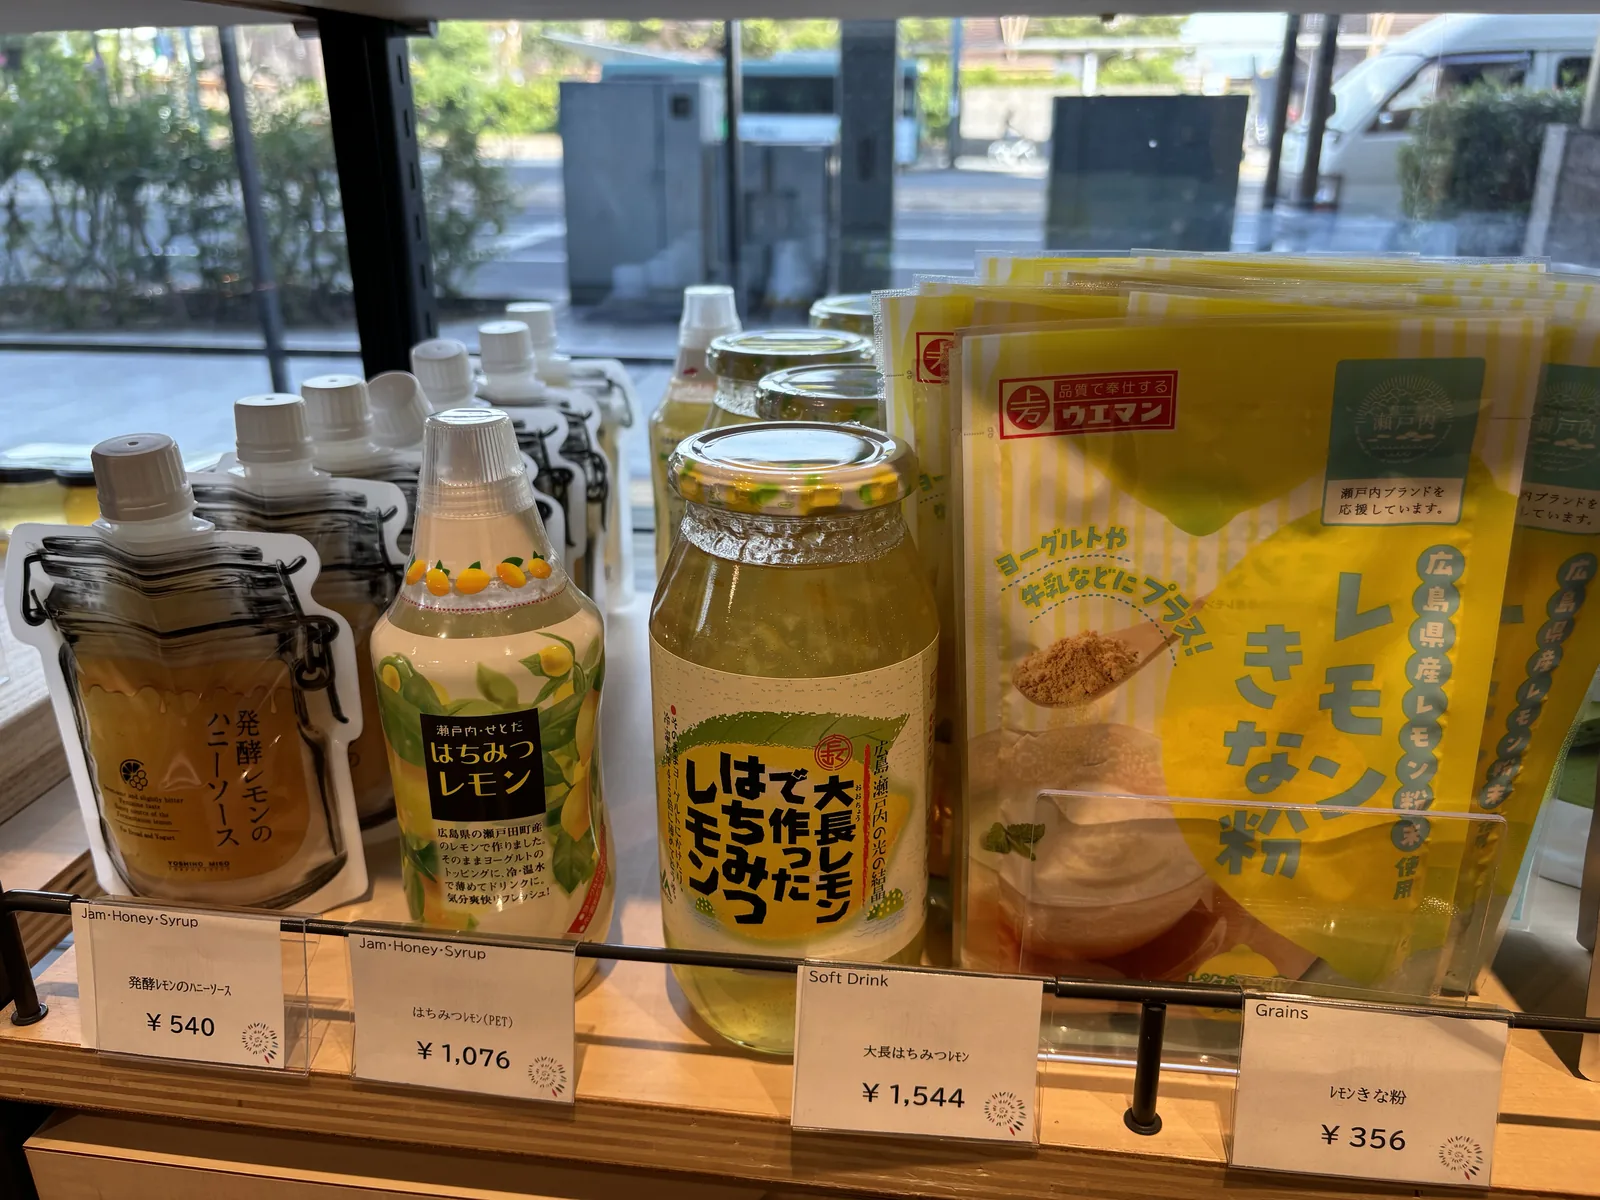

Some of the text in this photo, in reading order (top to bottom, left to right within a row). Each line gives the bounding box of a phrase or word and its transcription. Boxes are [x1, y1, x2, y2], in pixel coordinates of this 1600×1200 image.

[1059, 380, 1168, 398] 品質で奉仕する
[1062, 403, 1162, 426] ウエマン
[1340, 486, 1444, 499] 瀬戸内ブランドを
[1338, 502, 1443, 516] 応援しています。
[996, 526, 1127, 576] ヨーグルトや
[1308, 572, 1394, 820] レモン
[436, 720, 523, 737] 瀬戸内・せとだ
[431, 740, 534, 765] はちみつ
[1215, 624, 1309, 879] きな粉
[208, 713, 239, 847] ハニーソース
[236, 710, 272, 842] 発酵レモンの
[439, 769, 531, 796] レモン
[438, 822, 543, 839] 広島県の瀬戸田町産
[720, 752, 768, 925] はちみつ
[769, 768, 811, 902] で作った
[439, 837, 545, 852] のレモンで作りました。
[814, 775, 856, 924] 大長レモン
[442, 850, 544, 865] そのままヨーグルトの
[445, 862, 545, 879] トッピングに、冷・温水
[445, 877, 545, 892] で薄めてドリンクに。
[128, 976, 232, 997] 発酵レモンのハニーソース
[809, 970, 889, 987] Soft Drink
[1255, 1003, 1309, 1020] Grains
[170, 1015, 215, 1036] 540
[442, 1044, 510, 1069] 1,076
[863, 1045, 970, 1062] 大長はちみつレモン
[889, 1084, 965, 1108] 1,544
[1330, 1085, 1407, 1105] レモンきな粉
[1349, 1127, 1406, 1151] 356
